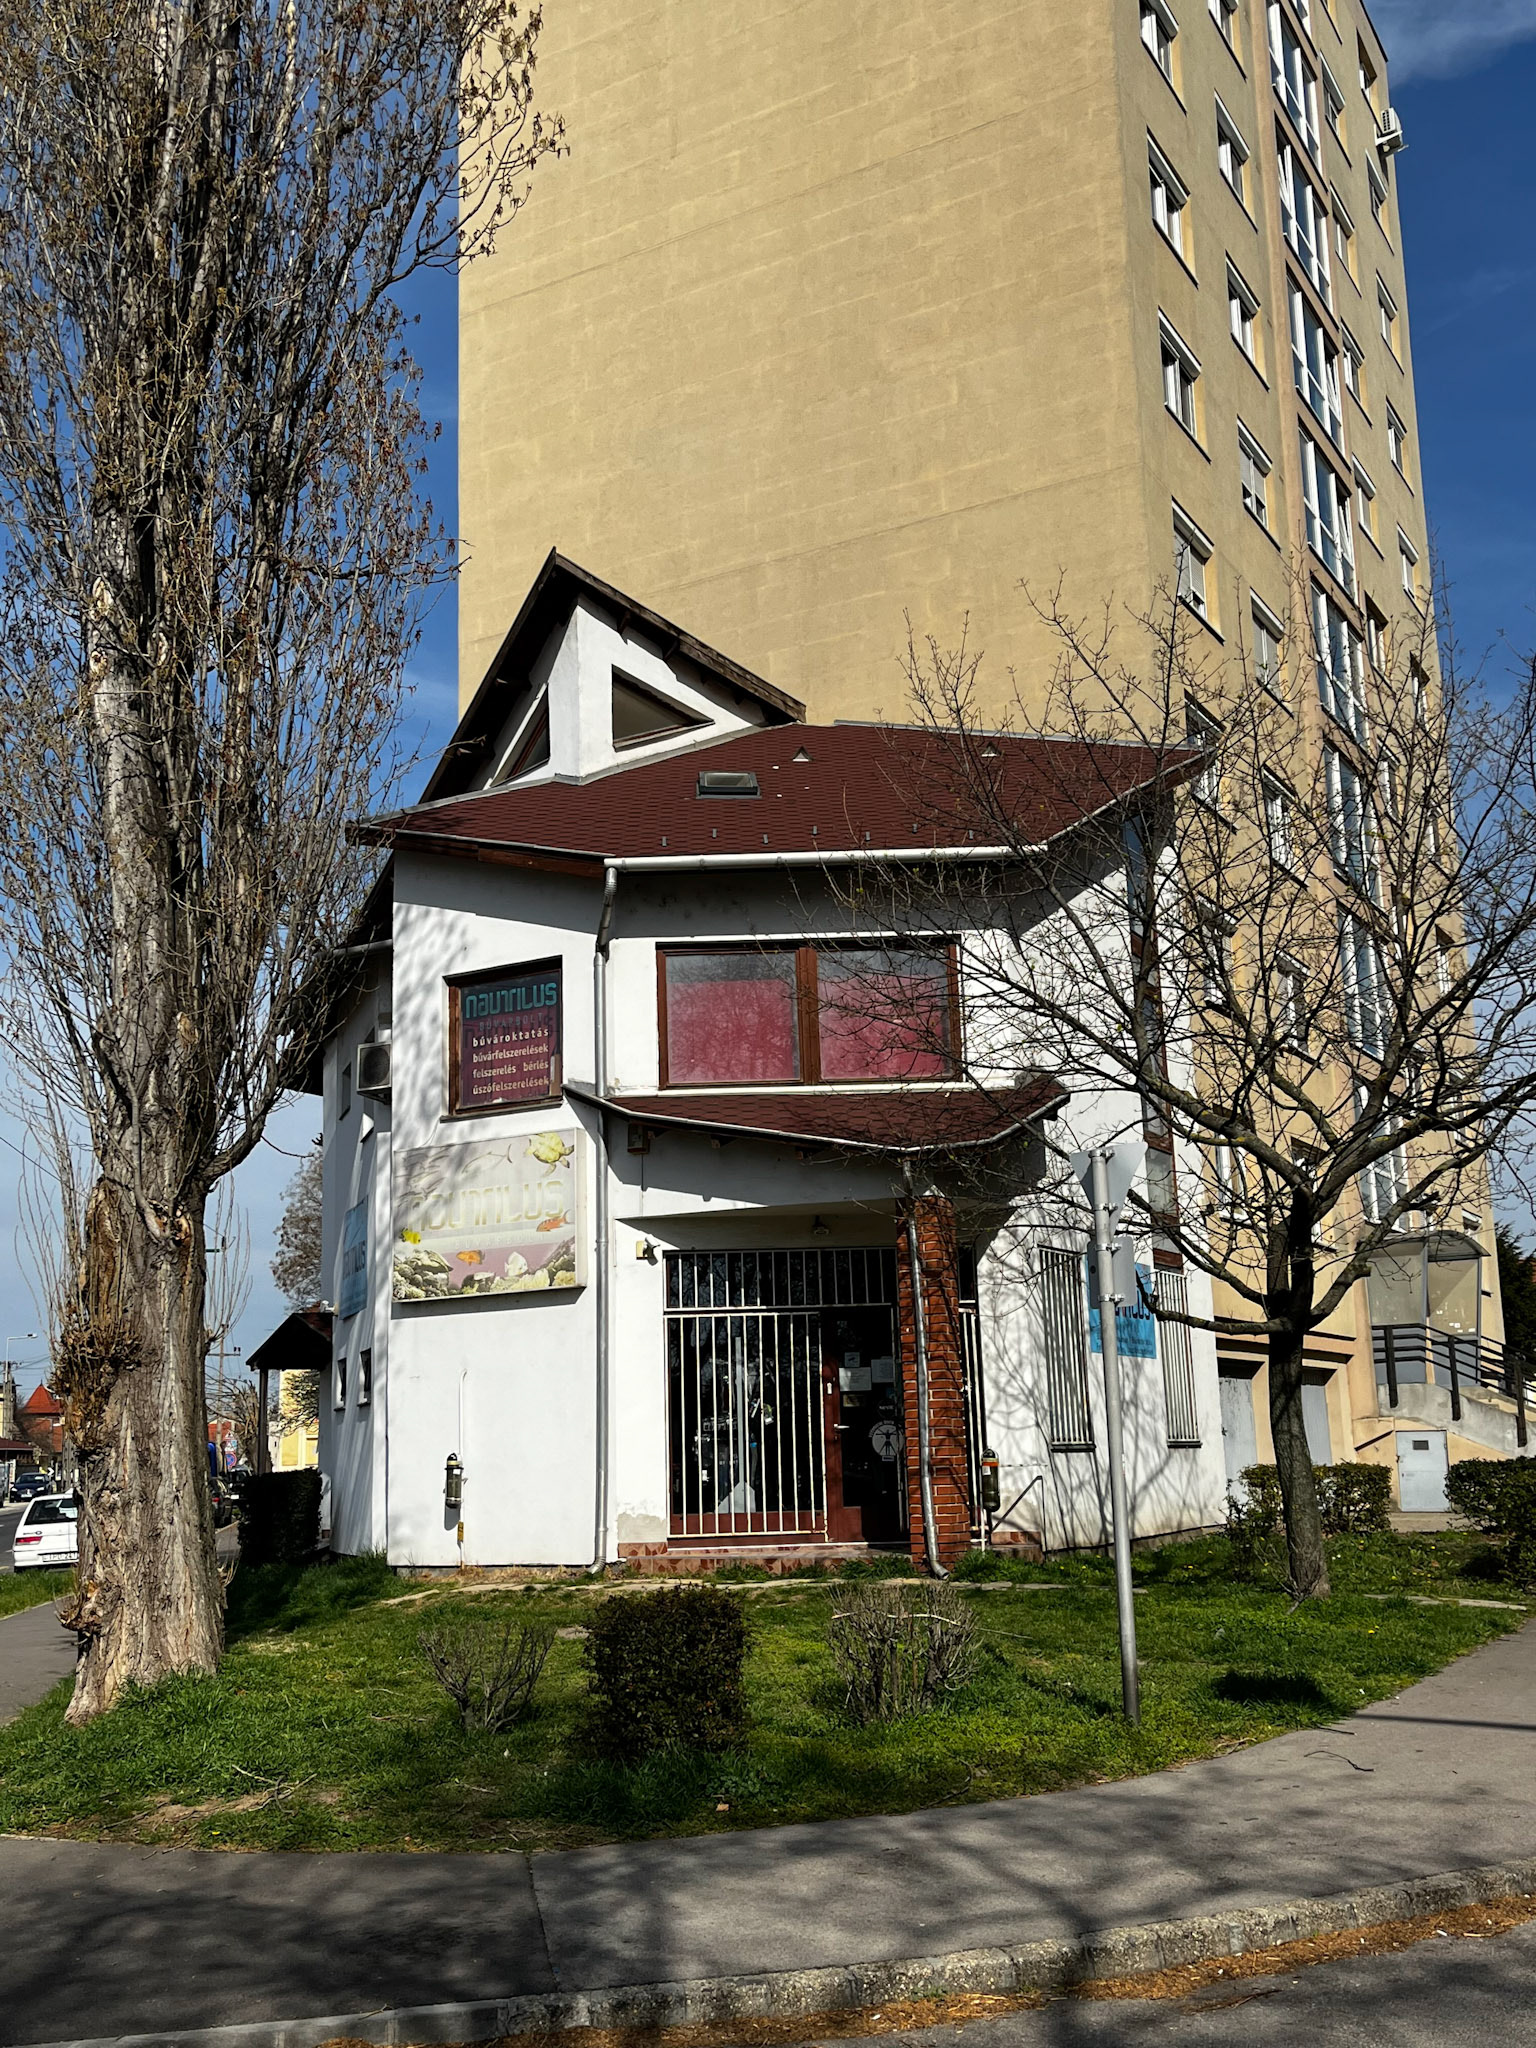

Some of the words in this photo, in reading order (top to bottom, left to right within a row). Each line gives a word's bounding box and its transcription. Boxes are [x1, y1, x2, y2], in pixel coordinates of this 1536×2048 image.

[473, 1028, 549, 1047] búvároktatás
[473, 1043, 549, 1062] búvárfelszerelések
[473, 1064, 517, 1078] felszerelés
[523, 1060, 549, 1071] bérlés
[473, 1076, 550, 1094] úszófelszerelések
